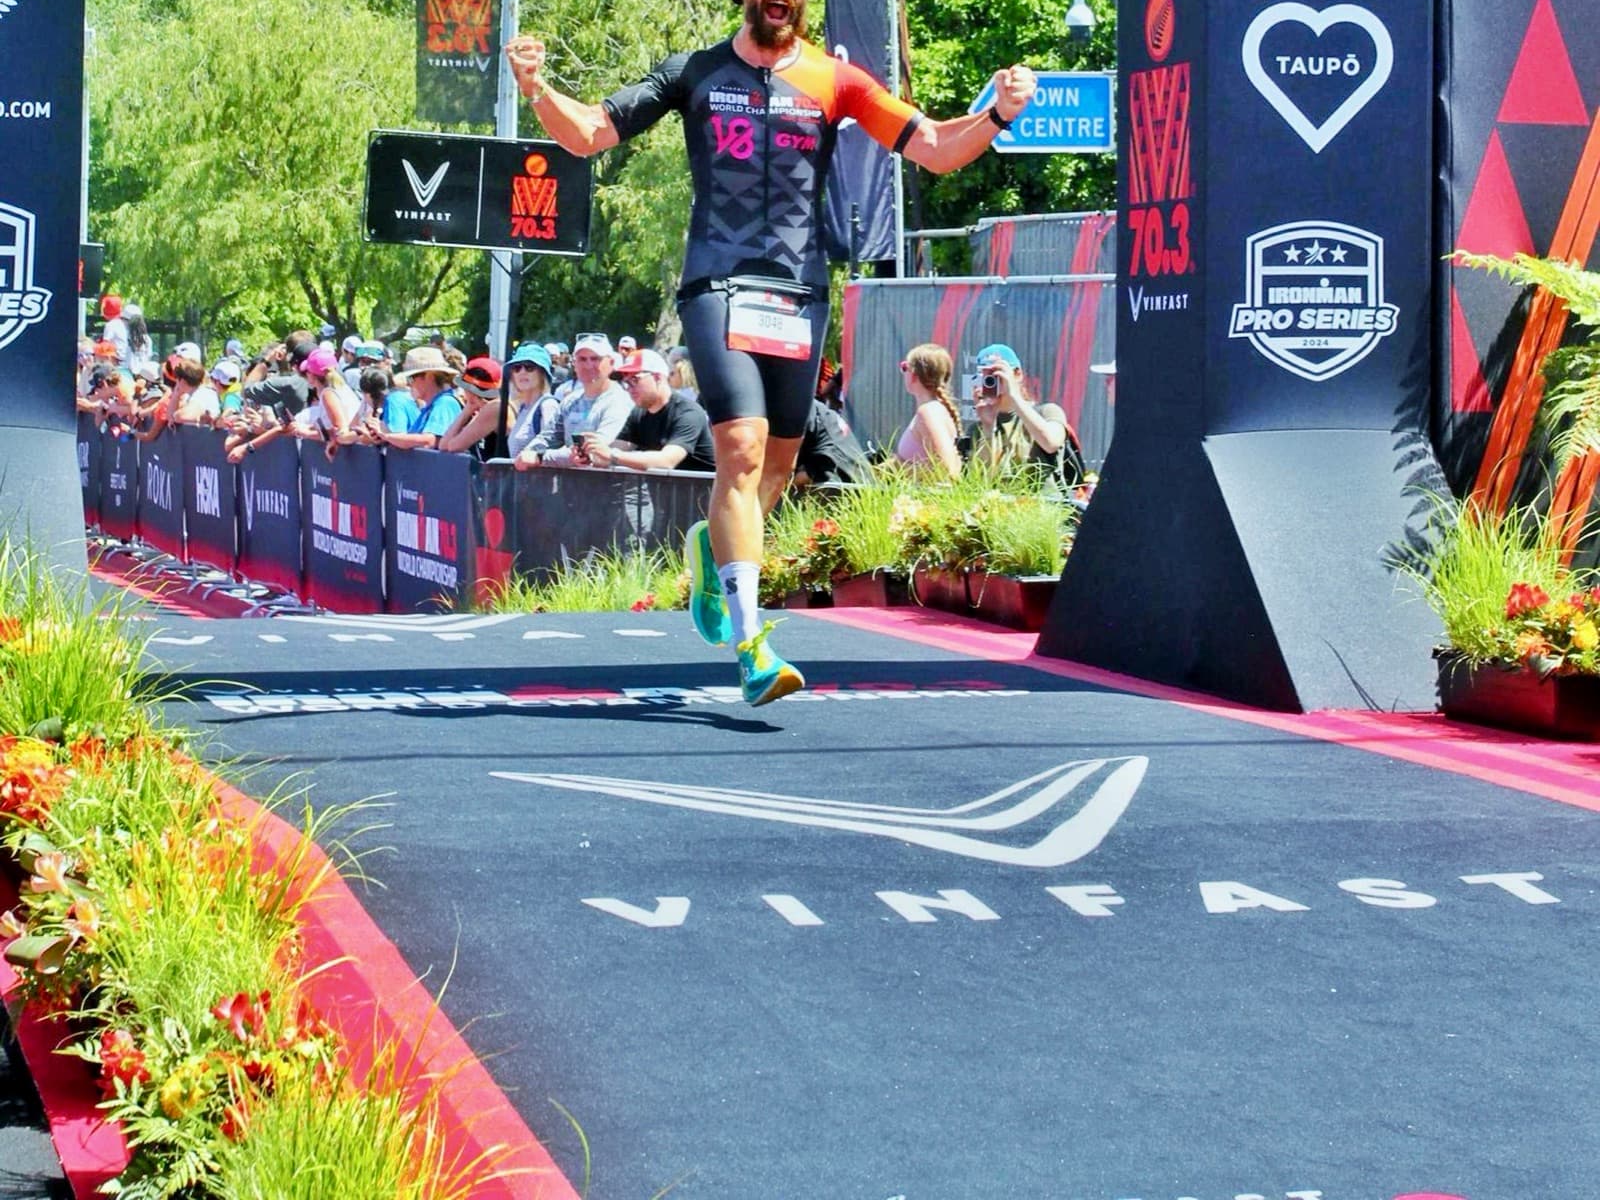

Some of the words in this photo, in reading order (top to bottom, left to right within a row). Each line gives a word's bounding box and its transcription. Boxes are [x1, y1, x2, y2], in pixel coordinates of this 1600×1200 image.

[1275, 52, 1361, 77] TAUPŌ
[710, 103, 744, 113] WORLD
[1032, 86, 1080, 108] OWN
[1019, 117, 1105, 139] CENTRE
[775, 132, 817, 151] GYM
[395, 209, 451, 222] VINFAST
[511, 217, 556, 239] 70.3
[1129, 203, 1190, 277] 70.3
[1143, 293, 1189, 311] VINFAST
[1268, 286, 1362, 305] IRONMAN
[1235, 308, 1295, 332] PRO
[1296, 308, 1394, 331] SERIES
[1302, 339, 1329, 347] 2024
[195, 465, 221, 518] HOKA
[256, 489, 289, 520] VINFAST
[220, 701, 488, 714] WORLD
[582, 870, 1562, 928] VINFAST
